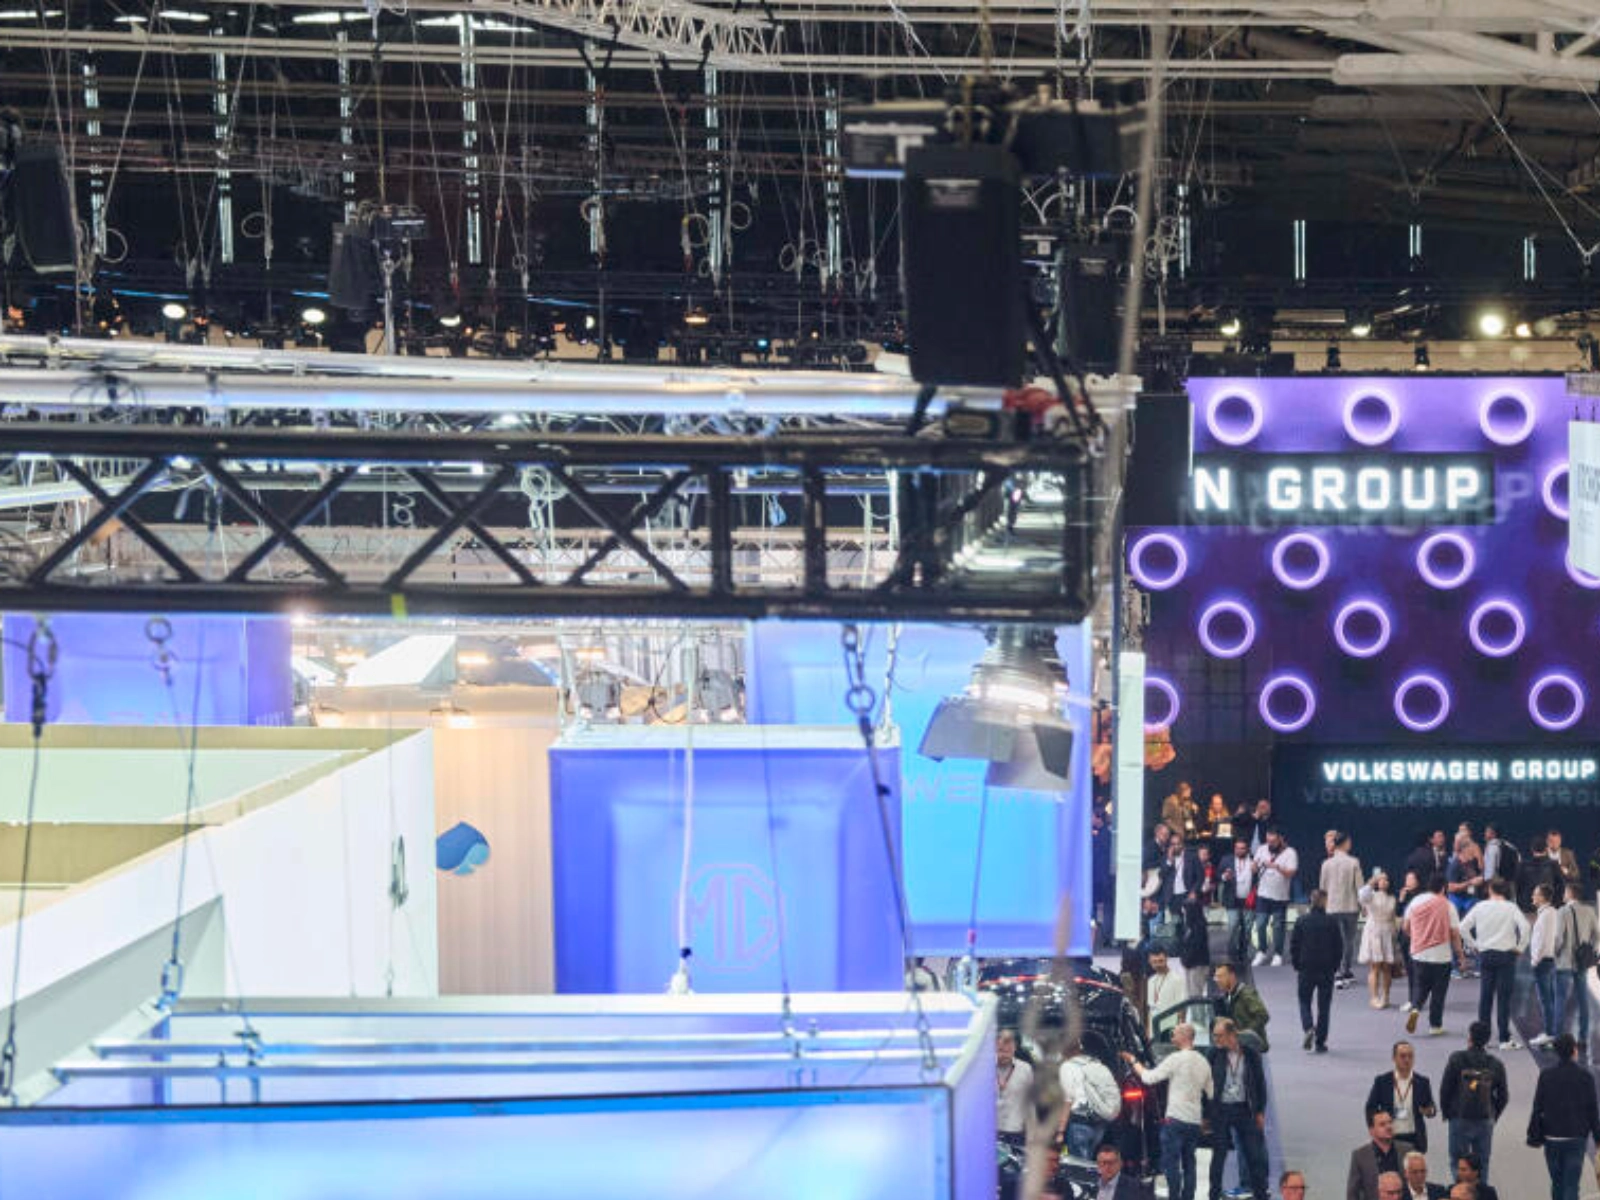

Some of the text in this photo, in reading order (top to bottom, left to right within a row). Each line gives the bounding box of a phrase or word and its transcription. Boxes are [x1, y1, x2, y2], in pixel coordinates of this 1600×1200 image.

[1268, 467, 1480, 511] GROUP
[1322, 760, 1499, 782] VOLKSWAGEN
[1509, 759, 1596, 781] GROUP
[678, 868, 780, 966] MG
